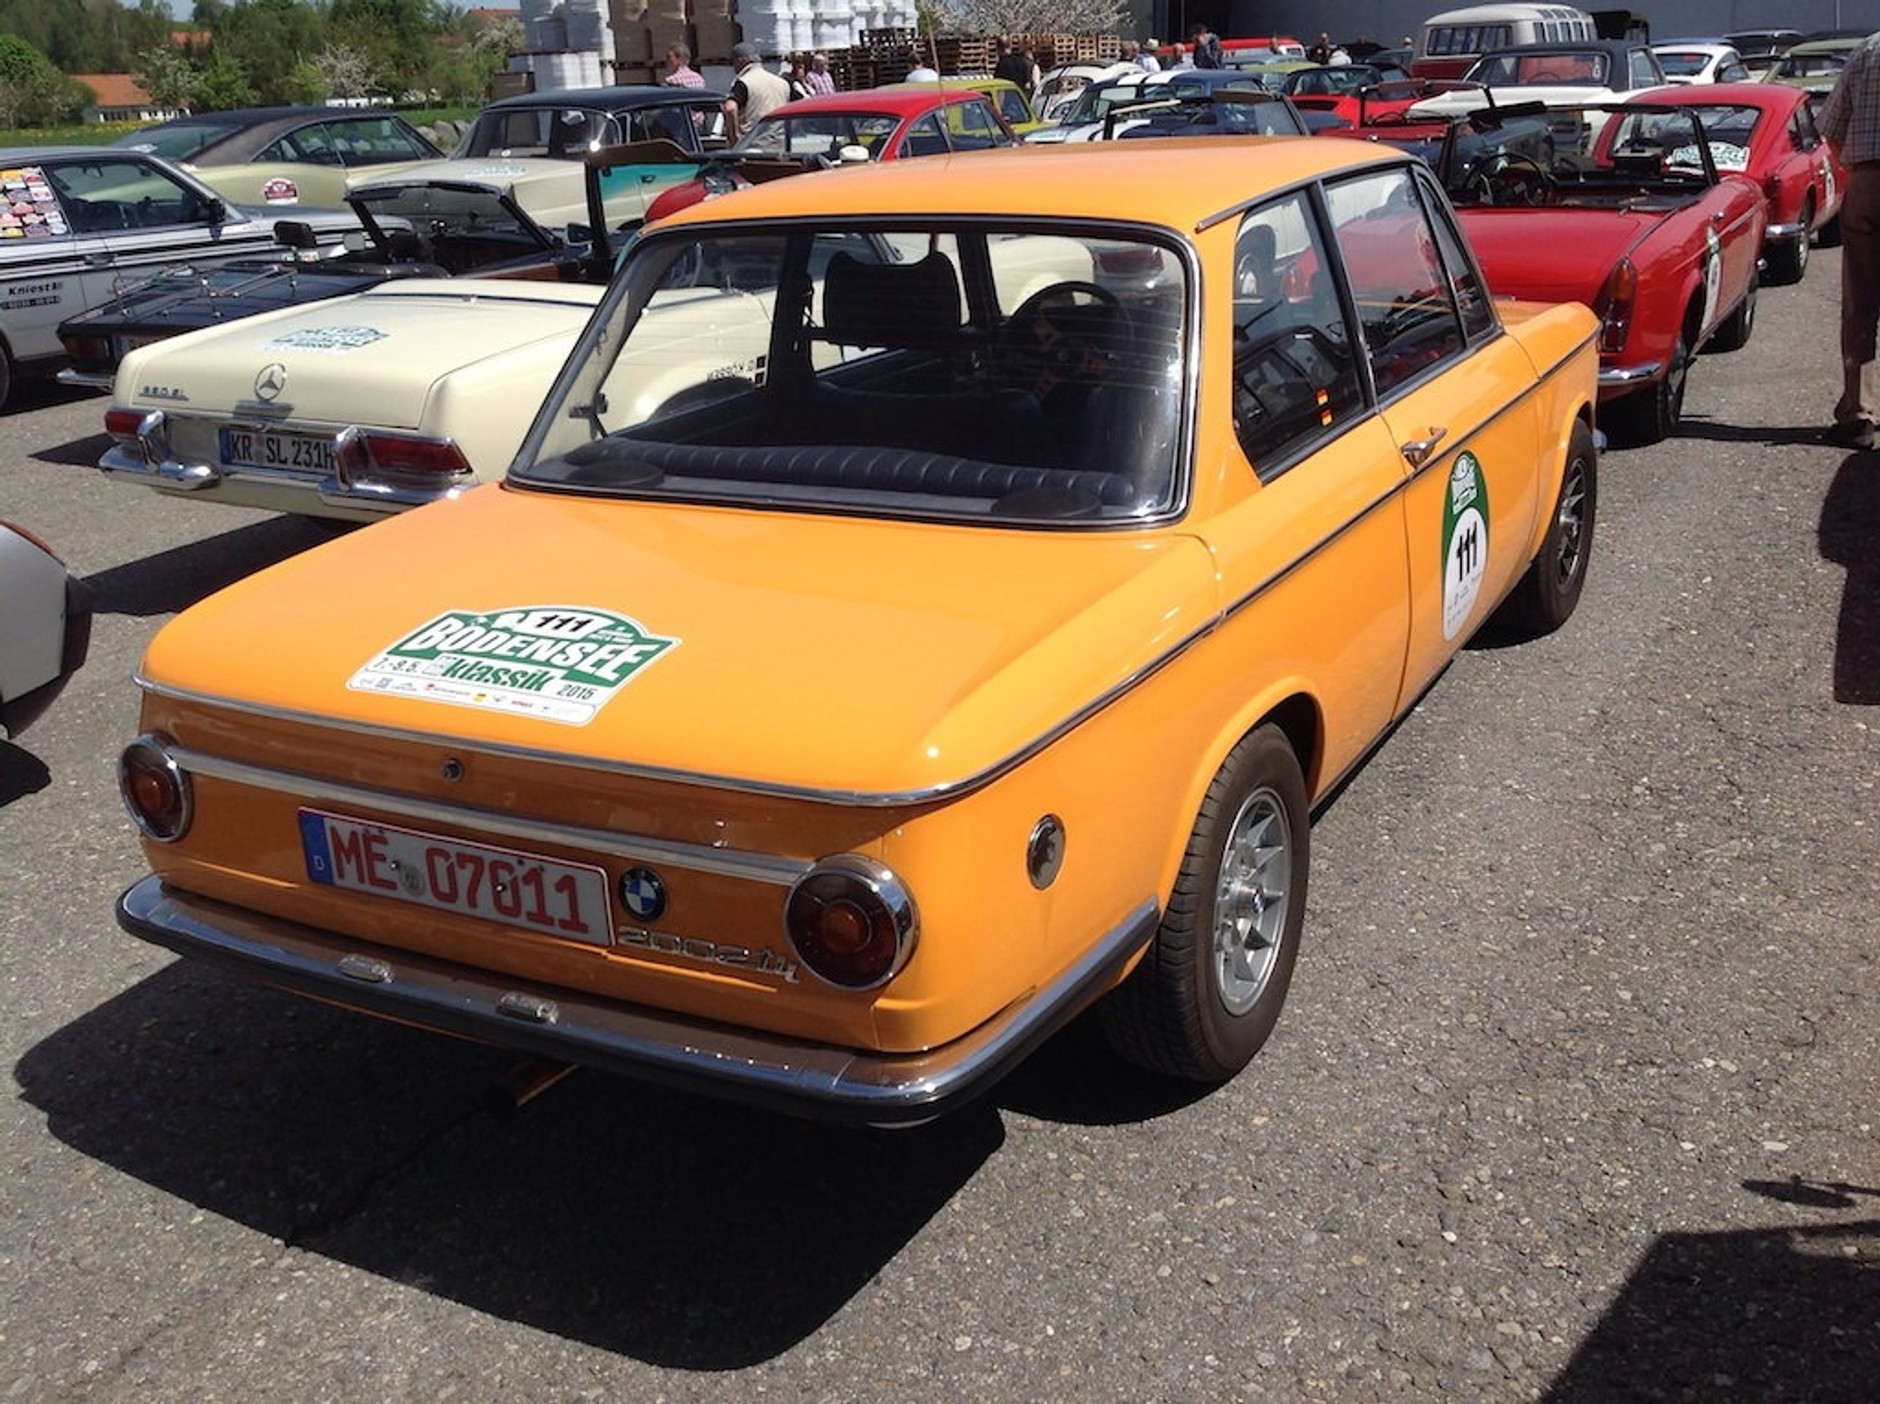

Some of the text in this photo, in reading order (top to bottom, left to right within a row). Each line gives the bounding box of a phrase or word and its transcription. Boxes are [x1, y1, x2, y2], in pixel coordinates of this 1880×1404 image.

[231, 433, 253, 460] KR
[266, 438, 287, 464] SL
[1456, 521, 1477, 581] 111
[535, 615, 594, 632] 111
[399, 616, 661, 681] BODENSEE
[441, 658, 556, 692] klassik
[557, 684, 598, 700] 2015
[330, 824, 588, 934] ME 07011
[618, 926, 749, 967] 2002
